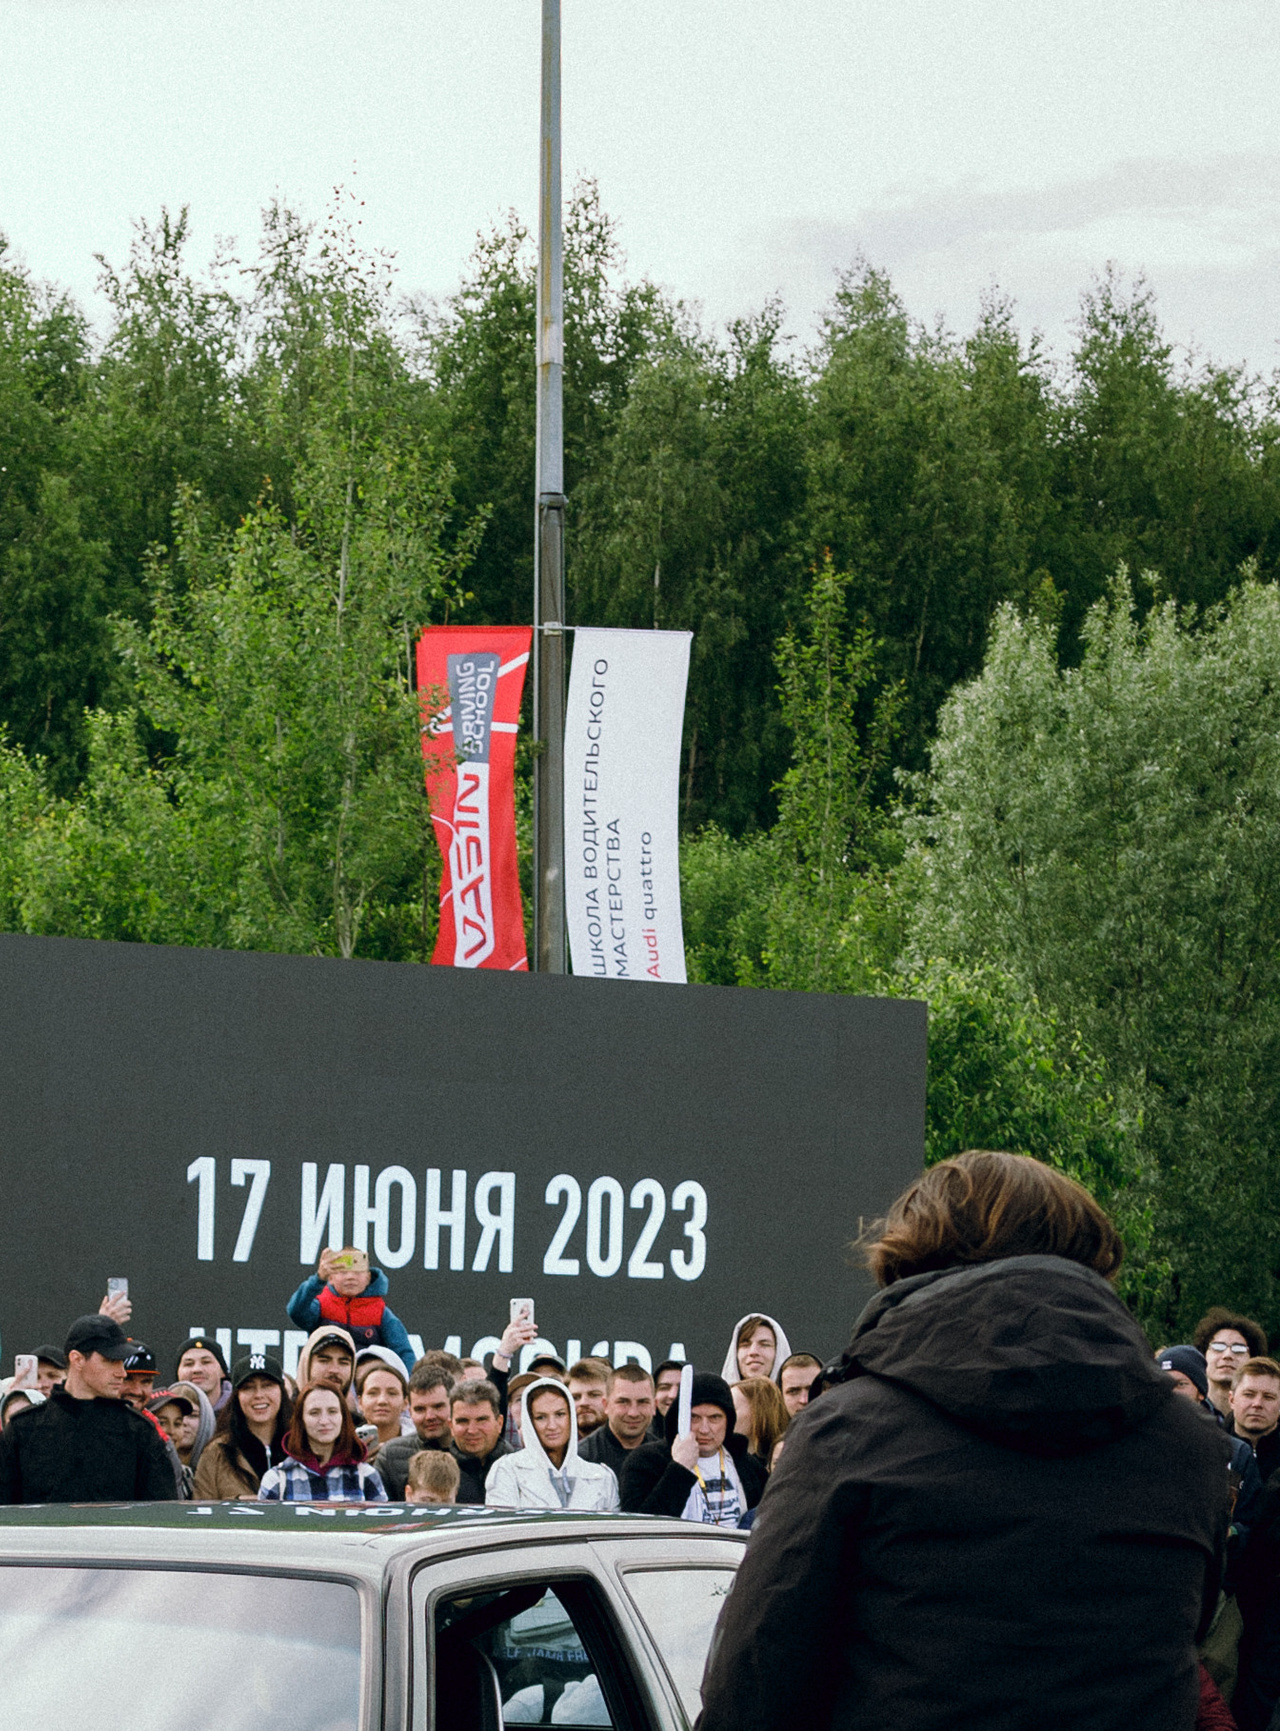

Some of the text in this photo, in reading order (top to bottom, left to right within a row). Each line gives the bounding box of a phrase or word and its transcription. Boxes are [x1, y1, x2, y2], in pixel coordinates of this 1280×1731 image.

[455, 661, 477, 754] DRIVING
[472, 660, 496, 755] SCHOOL
[582, 658, 609, 976] ШКОЛА ВОДИТЕЛЬСКОГО
[606, 818, 631, 978] МАСТЕРСТВА
[639, 831, 662, 979] Audi quattro
[186, 1155, 709, 1282] 17 ИЮНЯ 2023
